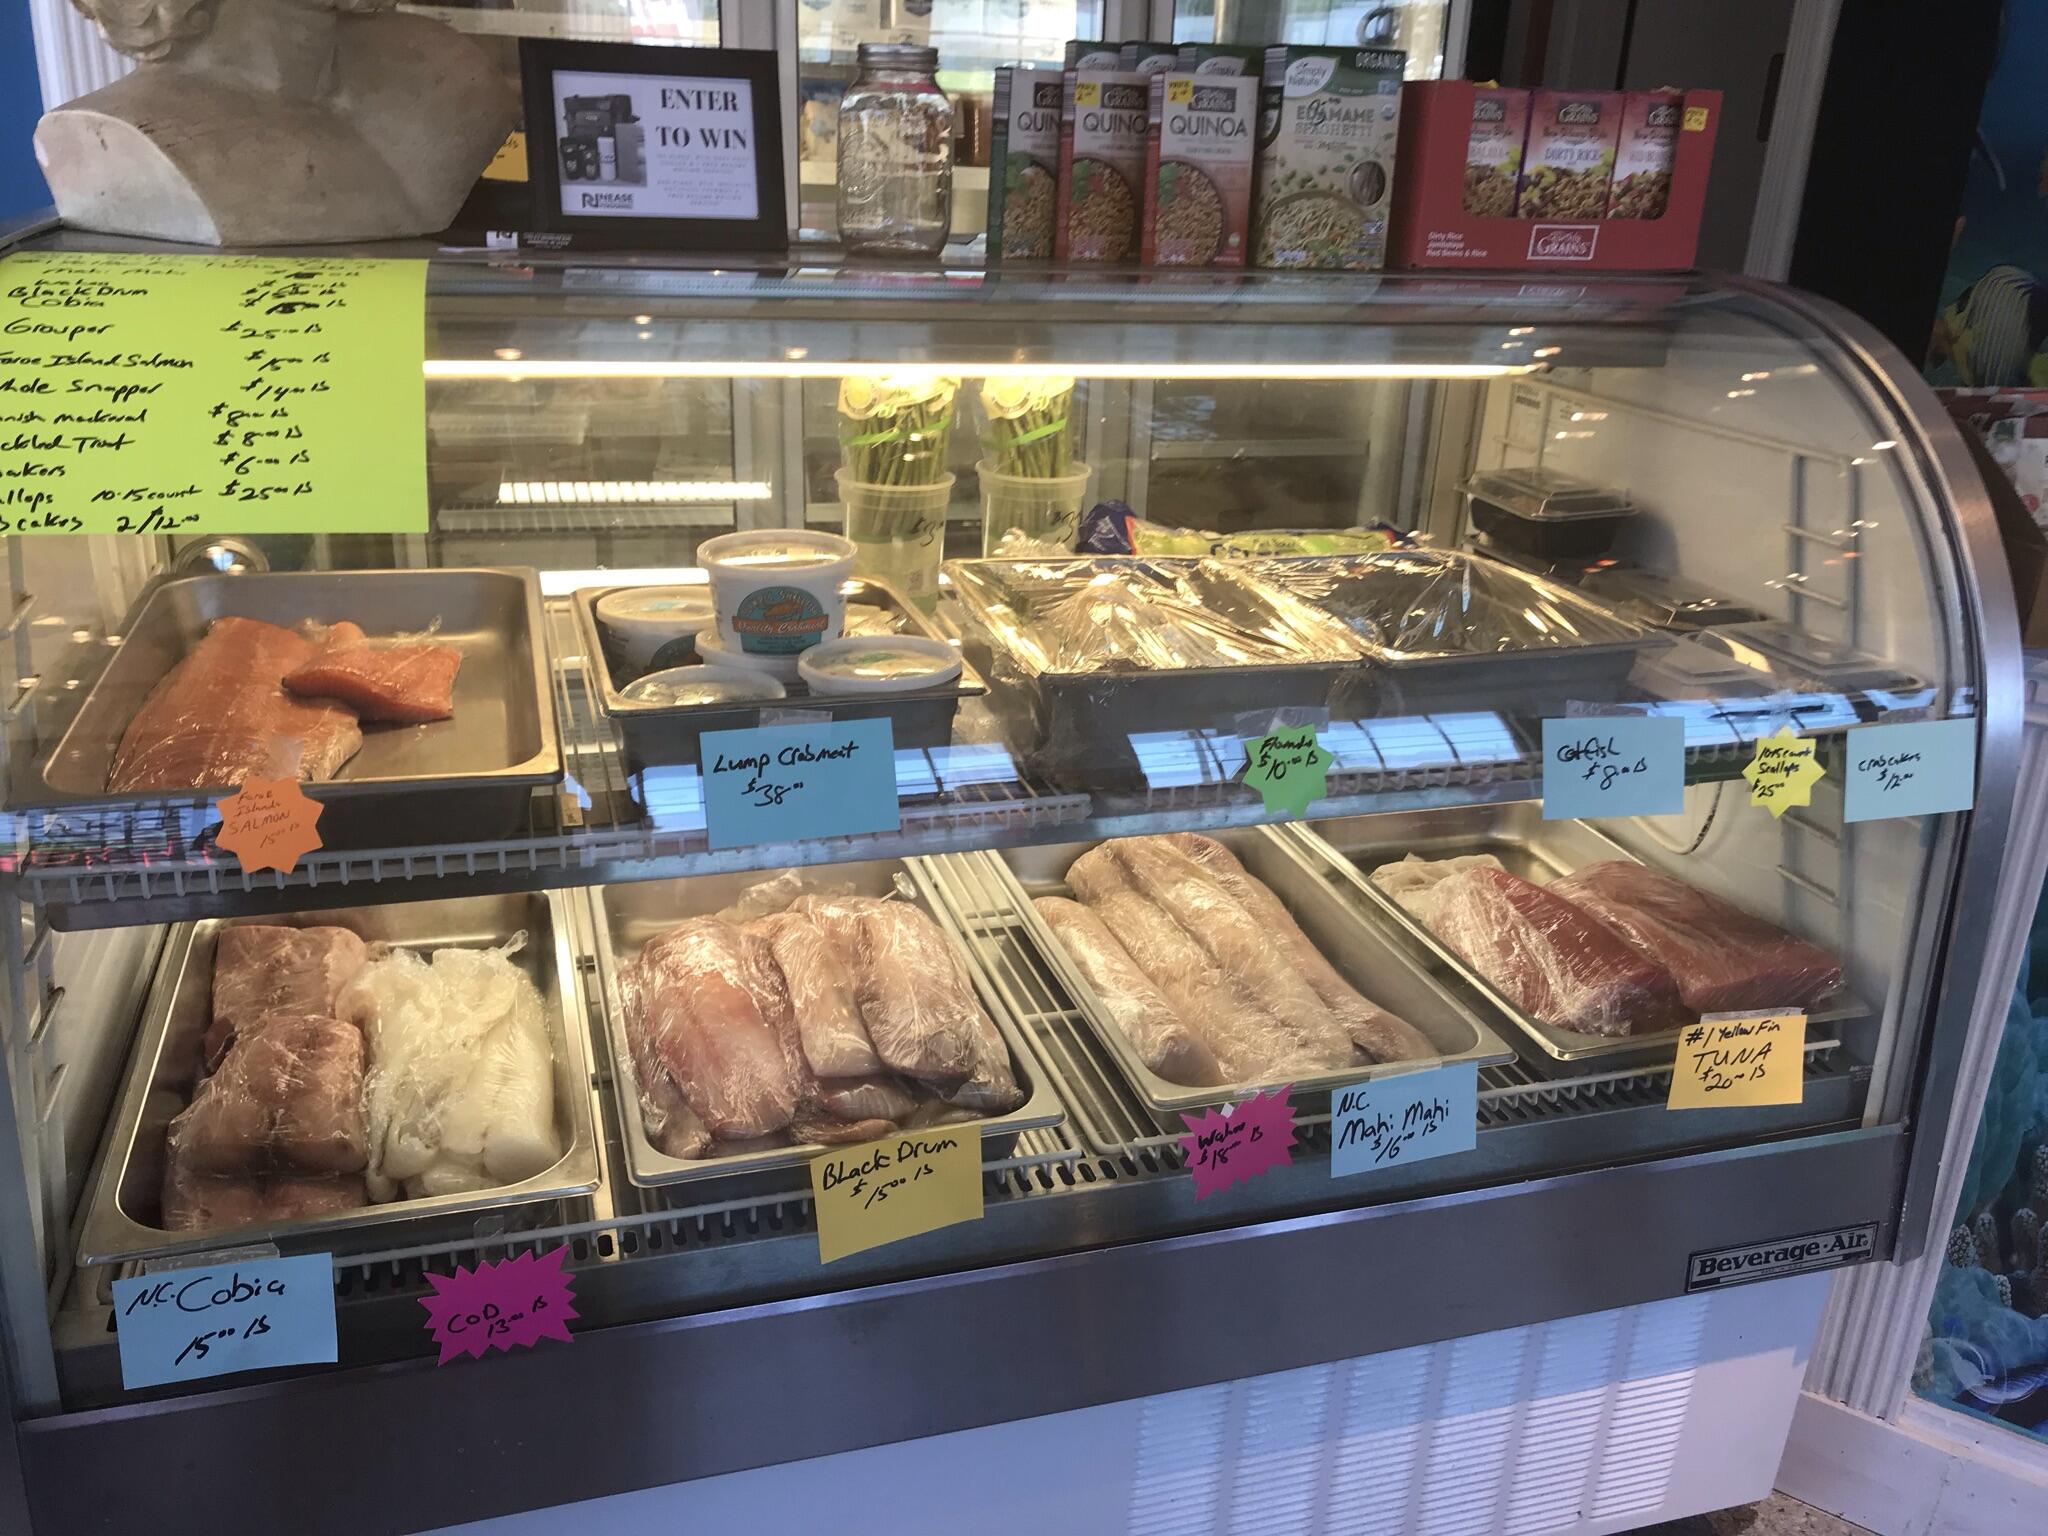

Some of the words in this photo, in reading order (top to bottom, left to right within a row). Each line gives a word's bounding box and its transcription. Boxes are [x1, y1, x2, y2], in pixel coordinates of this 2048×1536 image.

[660, 87, 740, 113] ENTER
[1017, 111, 1061, 133] QUIN
[1082, 112, 1149, 134] QUINO
[1169, 115, 1248, 138] QUINOA
[656, 126, 691, 148] TO
[699, 127, 748, 150] WIN
[97, 287, 148, 297] Drum
[4, 317, 115, 341] Grouper
[42, 351, 123, 368] Island
[122, 352, 194, 368] Salmon
[66, 379, 164, 403] Snapper
[0, 410, 46, 424] nish
[0, 433, 71, 451] ckled
[0, 462, 67, 478] akers
[0, 488, 54, 513] llops
[713, 753, 771, 778] Lump
[777, 741, 860, 767] Crabmeat
[229, 810, 290, 836] SALMON
[1685, 1026, 1715, 1048] #1
[1718, 1023, 1756, 1042] Yellow
[1755, 1020, 1780, 1035] Fin
[1693, 1041, 1772, 1073] TUNA
[1338, 1113, 1394, 1149] Mahi
[1402, 1097, 1449, 1131] Mahi
[897, 1139, 958, 1163] Drum
[176, 1272, 286, 1313] Cobia
